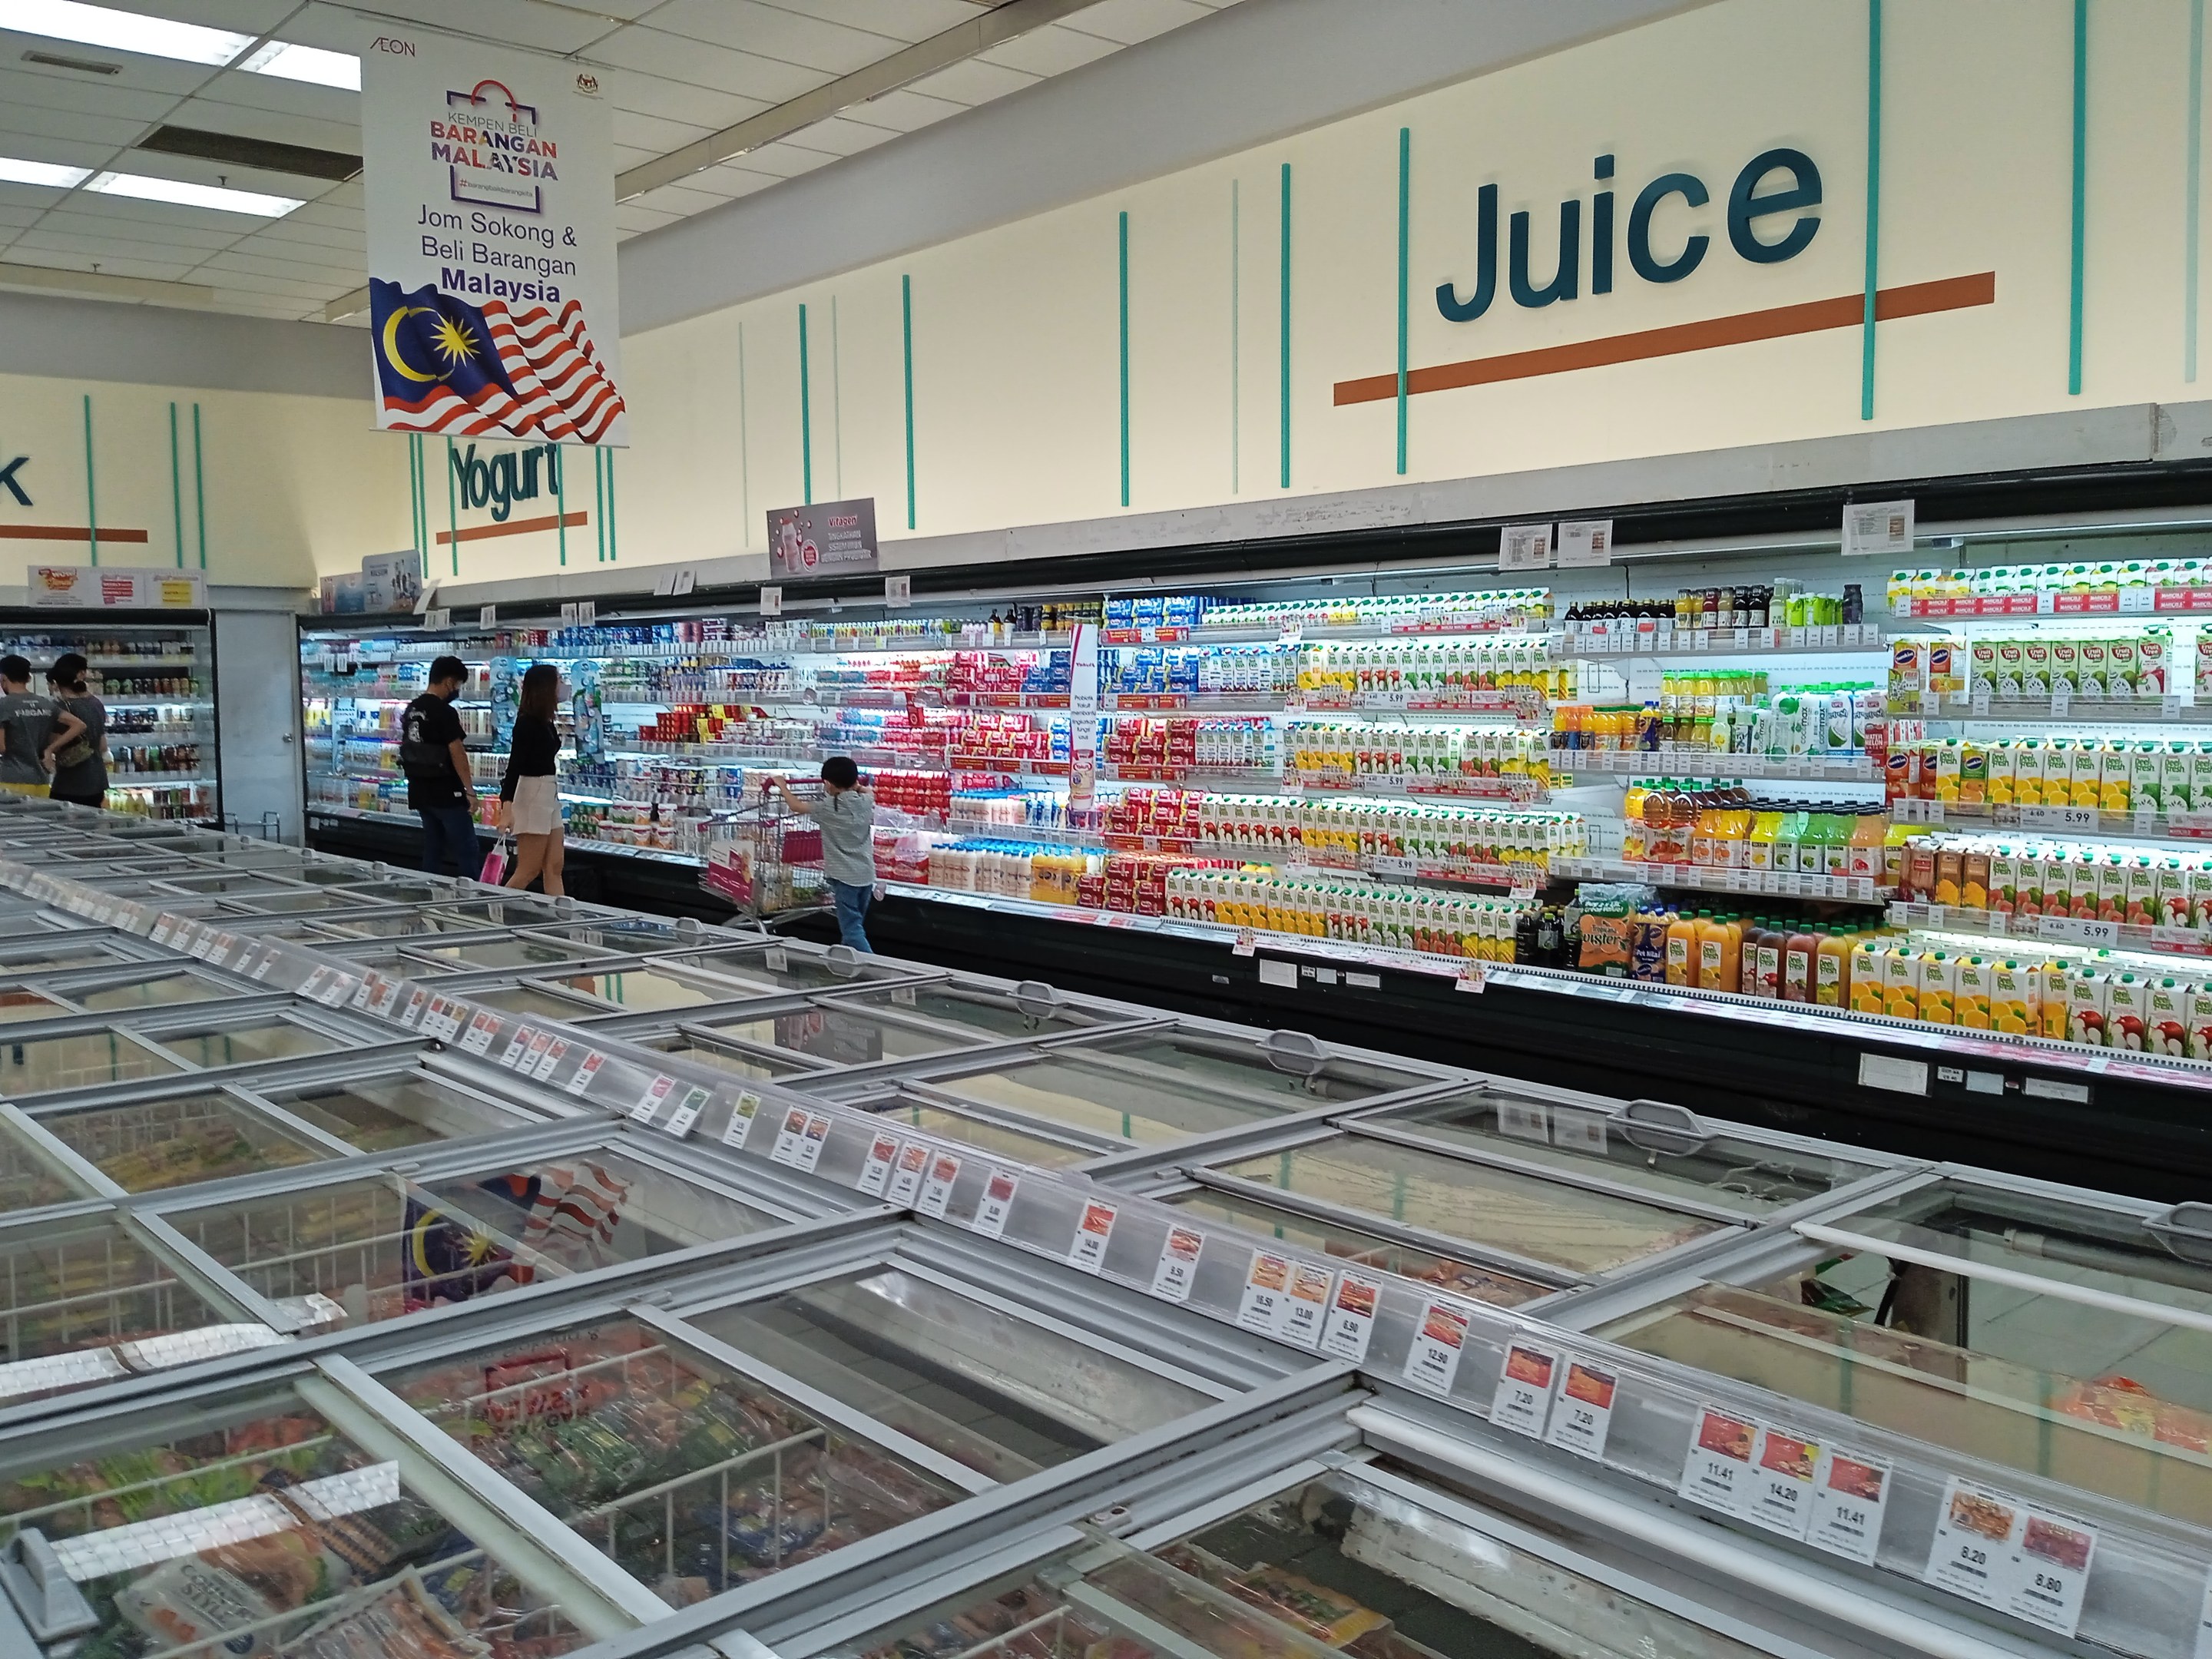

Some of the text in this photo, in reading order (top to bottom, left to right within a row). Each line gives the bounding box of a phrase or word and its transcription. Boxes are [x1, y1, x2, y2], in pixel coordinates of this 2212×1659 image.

[448, 111, 537, 137] KEMPEN BELI
[430, 121, 558, 158] BARANGAN
[431, 142, 558, 180] MALAYSIA
[418, 204, 578, 249] Jom Sokong &
[1435, 147, 1823, 323] Juice
[422, 235, 576, 277] Beli Barangan
[441, 267, 561, 303] Malaysia
[453, 443, 558, 522] Yogurt
[2065, 813, 2090, 823] 5.99
[1398, 860, 1412, 869] 5.99
[2083, 926, 2108, 937] 5.99
[1295, 1306, 1313, 1320] 13.00
[1428, 1347, 1449, 1365] 12.90
[1515, 1389, 1533, 1405] 7.20
[1575, 1409, 1594, 1426] 7.20
[1707, 1462, 1734, 1481] 11.41
[1770, 1482, 1798, 1502] 14.20
[1836, 1506, 1866, 1526] 11.41
